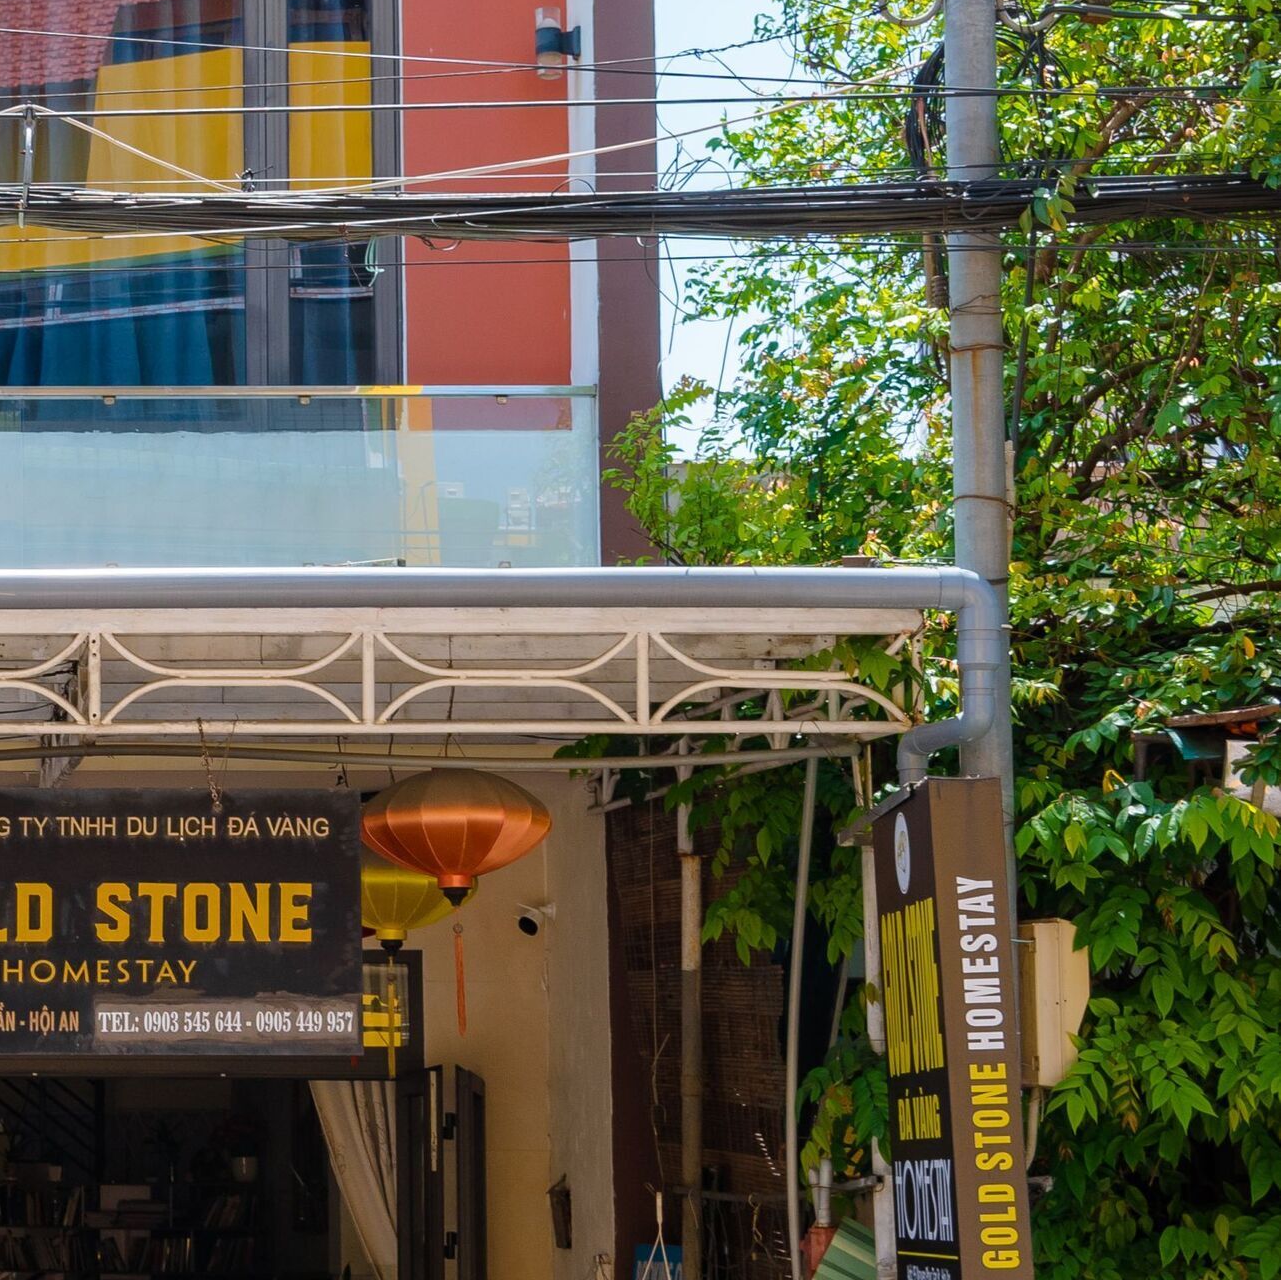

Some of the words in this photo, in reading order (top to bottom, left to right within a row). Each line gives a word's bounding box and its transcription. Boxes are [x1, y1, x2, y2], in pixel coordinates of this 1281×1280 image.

[18, 816, 49, 837] TY
[56, 816, 117, 837] TNHH
[126, 816, 158, 837] DU
[167, 816, 217, 841] LỊCH
[227, 811, 260, 837] ĐÁ
[266, 811, 330, 837] VÀNG
[94, 882, 312, 942] STONE
[2, 959, 198, 984] HOMESTAY
[955, 876, 1006, 1051] HOMESTAY
[29, 1005, 55, 1037] HỘI
[59, 1010, 80, 1032] AN
[98, 1011, 139, 1033] TEL:
[144, 1011, 179, 1033] 0903
[184, 1011, 211, 1033] 545
[215, 1011, 242, 1033] 644
[256, 1011, 291, 1033] 0905
[296, 1011, 323, 1033] 449
[327, 1011, 354, 1033] 957
[898, 1088, 913, 1141] ĐÁ
[912, 1086, 942, 1140] VÀNG
[969, 1063, 1014, 1170] STONE
[894, 1158, 954, 1242] HOMESTAY
[977, 1183, 1020, 1269] GOLD
